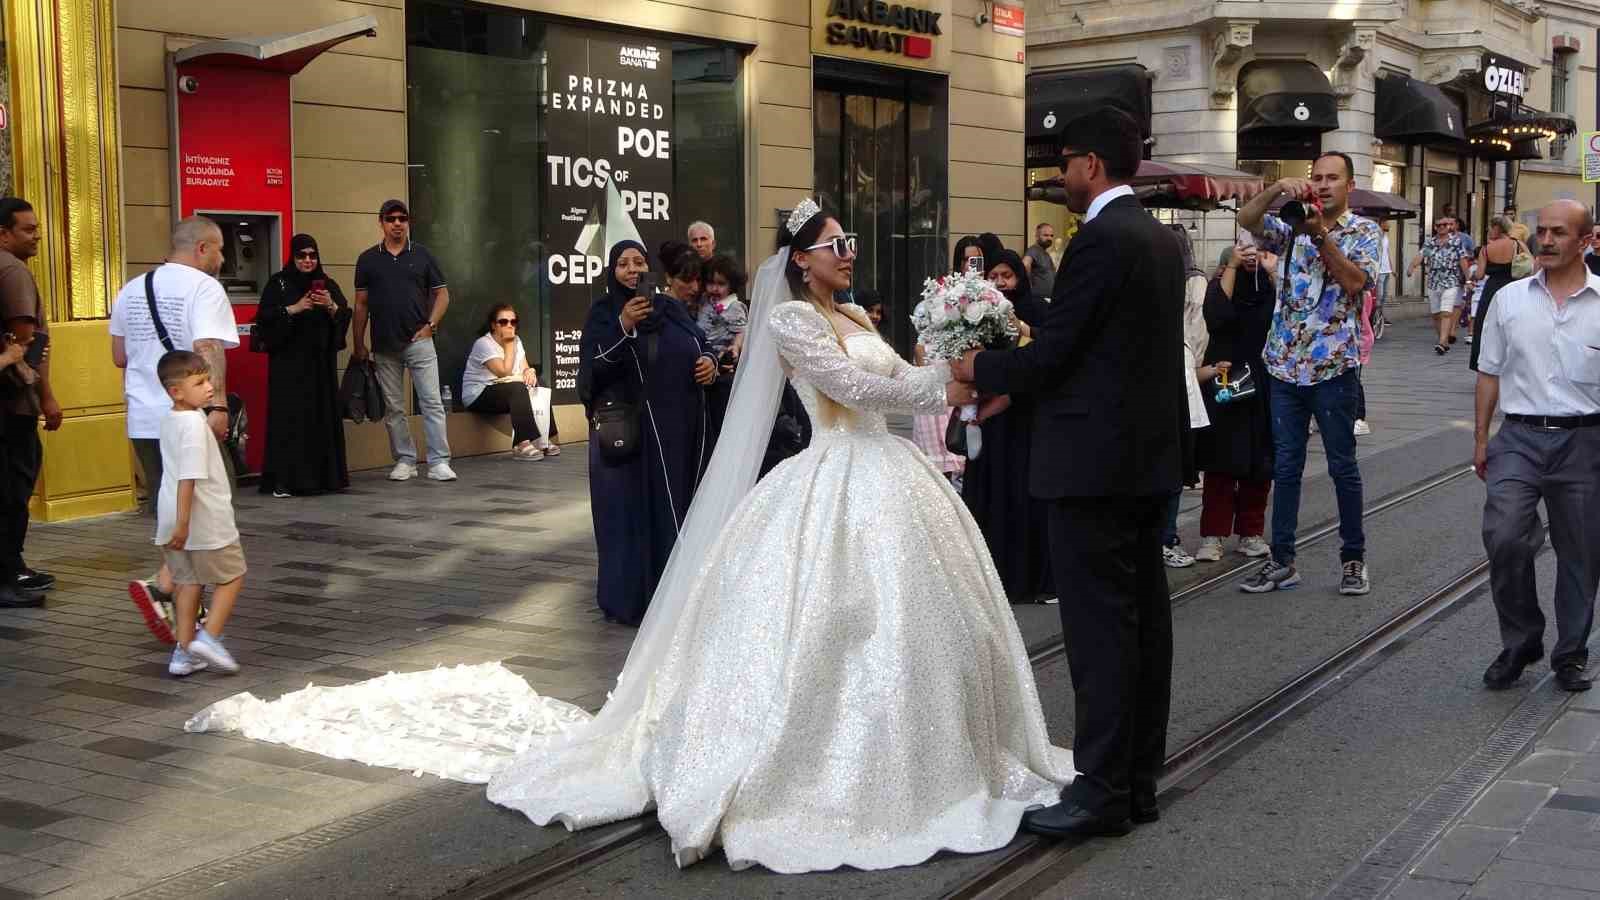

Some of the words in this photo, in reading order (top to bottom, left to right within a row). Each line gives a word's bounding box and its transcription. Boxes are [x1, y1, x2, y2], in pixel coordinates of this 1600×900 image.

[826, 0, 942, 35] AKBANK
[826, 22, 903, 53] SANAT
[620, 46, 661, 61] AKBANK
[620, 57, 647, 68] SANAT
[568, 75, 648, 100] PRIZMA
[552, 93, 664, 120] EXPANDED
[617, 126, 670, 159] POE
[547, 155, 612, 189] TICS
[614, 170, 630, 182] OF
[621, 190, 670, 220] PER
[548, 254, 603, 285] CEP
[555, 379, 576, 389] 2023
